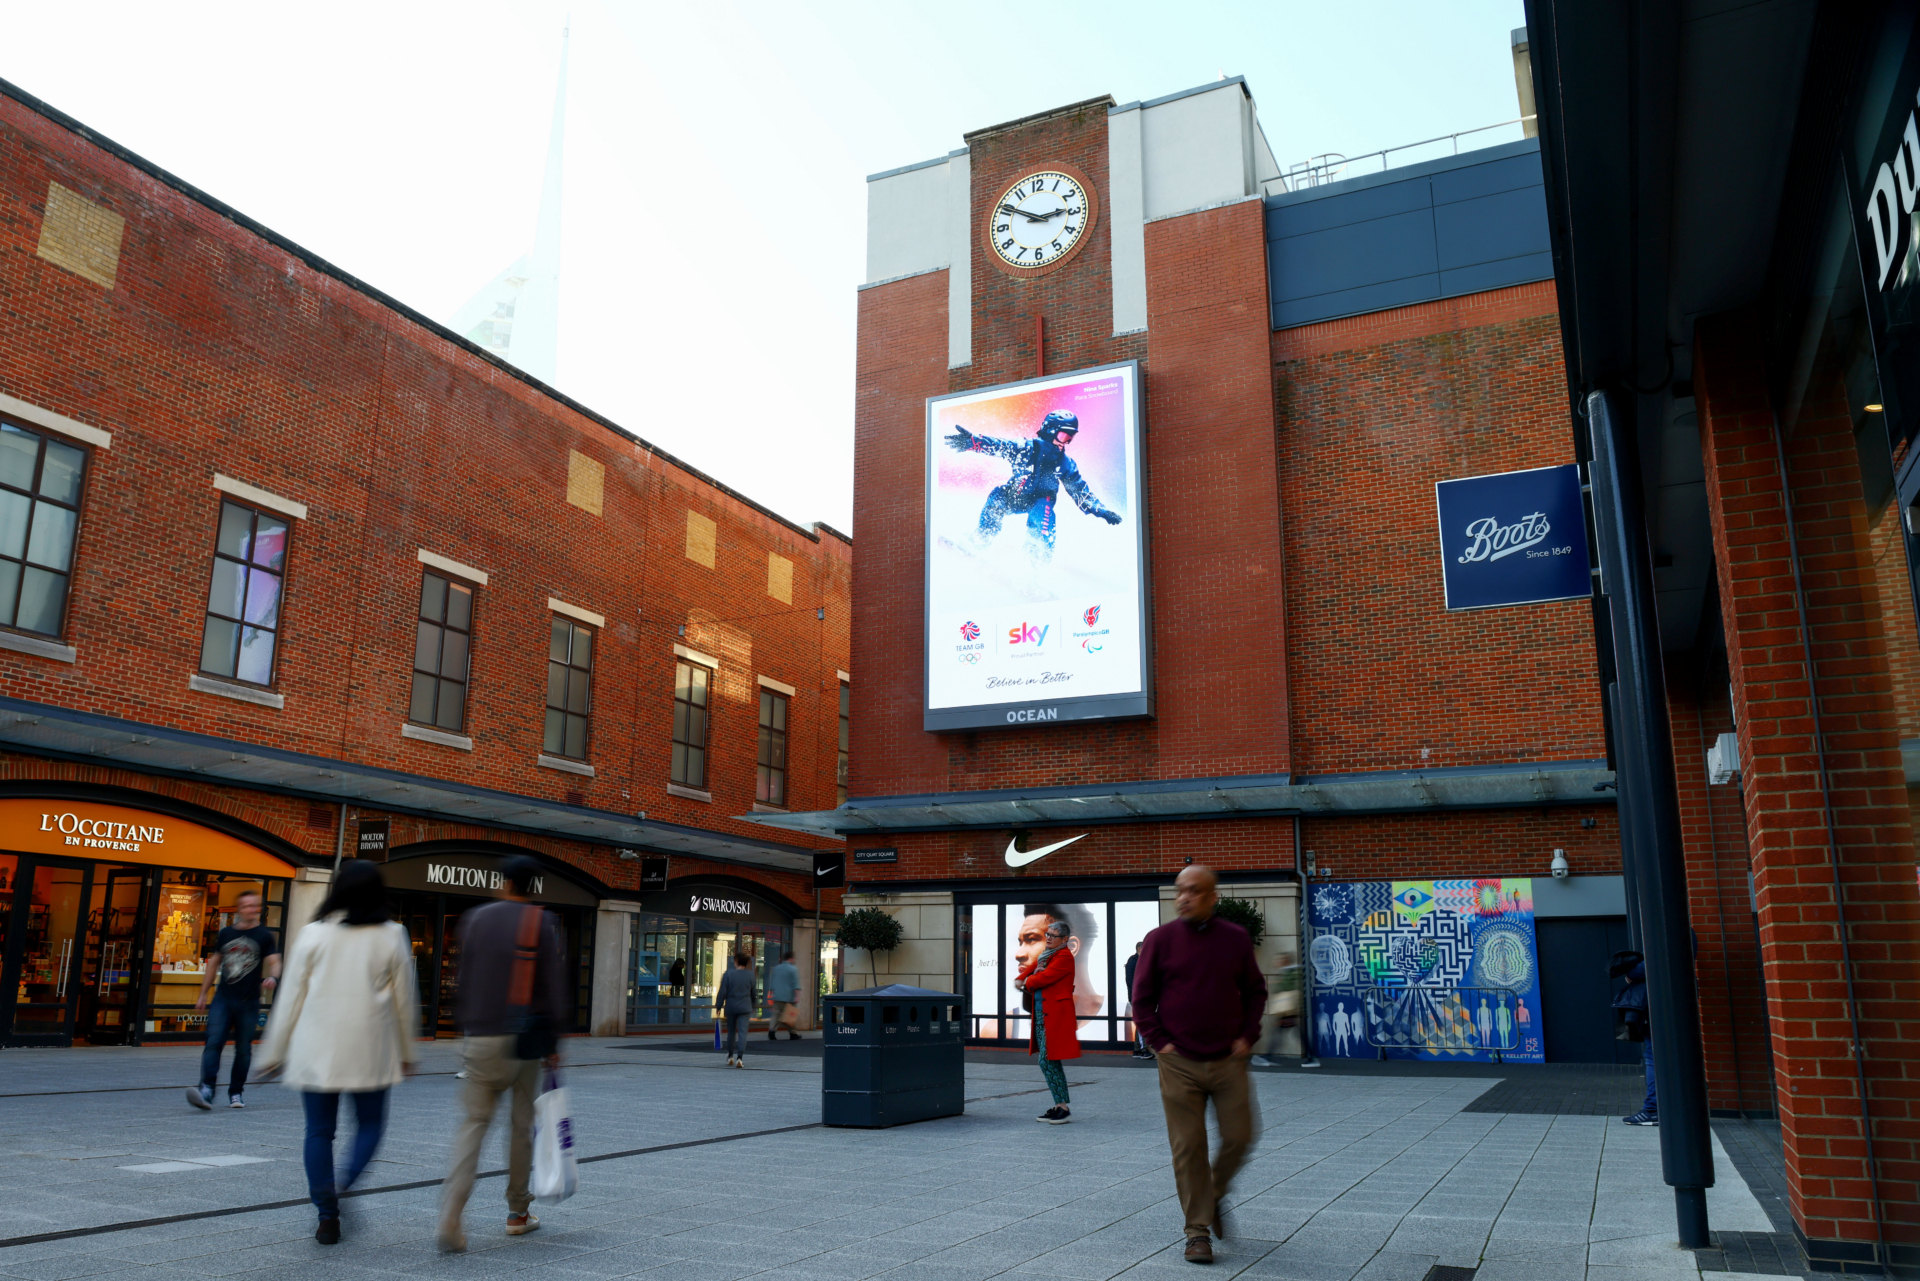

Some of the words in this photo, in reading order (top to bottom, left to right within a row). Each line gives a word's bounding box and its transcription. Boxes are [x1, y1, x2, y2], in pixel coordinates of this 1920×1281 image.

[1031, 179, 1044, 193] 12
[1052, 180, 1060, 192] 1
[1866, 86, 1920, 293] Du
[1014, 188, 1026, 201] 11
[1062, 188, 1075, 202] 2
[1068, 206, 1081, 216] 3
[997, 223, 1010, 233] 9
[1064, 225, 1077, 235] 4
[1001, 238, 1015, 250] 8
[1051, 239, 1063, 252] 5
[1016, 246, 1028, 260] 7
[1034, 247, 1043, 261] 6
[1097, 382, 1118, 391] Sparks
[1088, 389, 1119, 398] Snowboard
[1458, 511, 1551, 564] Boots
[1526, 550, 1549, 559] Since
[1551, 546, 1572, 556] 1849
[1009, 622, 1049, 647] sky
[1073, 629, 1110, 638] ParalympicsGB
[956, 644, 974, 652] TEAM
[986, 677, 1024, 689] Believe
[1025, 676, 1038, 685] in
[1039, 671, 1074, 685] Better
[1007, 708, 1058, 722] OCEAN
[361, 833, 385, 841] MOLTON
[65, 836, 80, 846] EN
[84, 838, 140, 852] PROVENCE
[360, 841, 384, 850] BROWN
[426, 863, 488, 888] MOLTON
[702, 897, 751, 915] SWAROVSKI
[837, 1026, 858, 1034] Litter
[907, 1025, 920, 1033] Plastic
[1525, 1037, 1538, 1045] HS
[1525, 1044, 1539, 1052] DC
